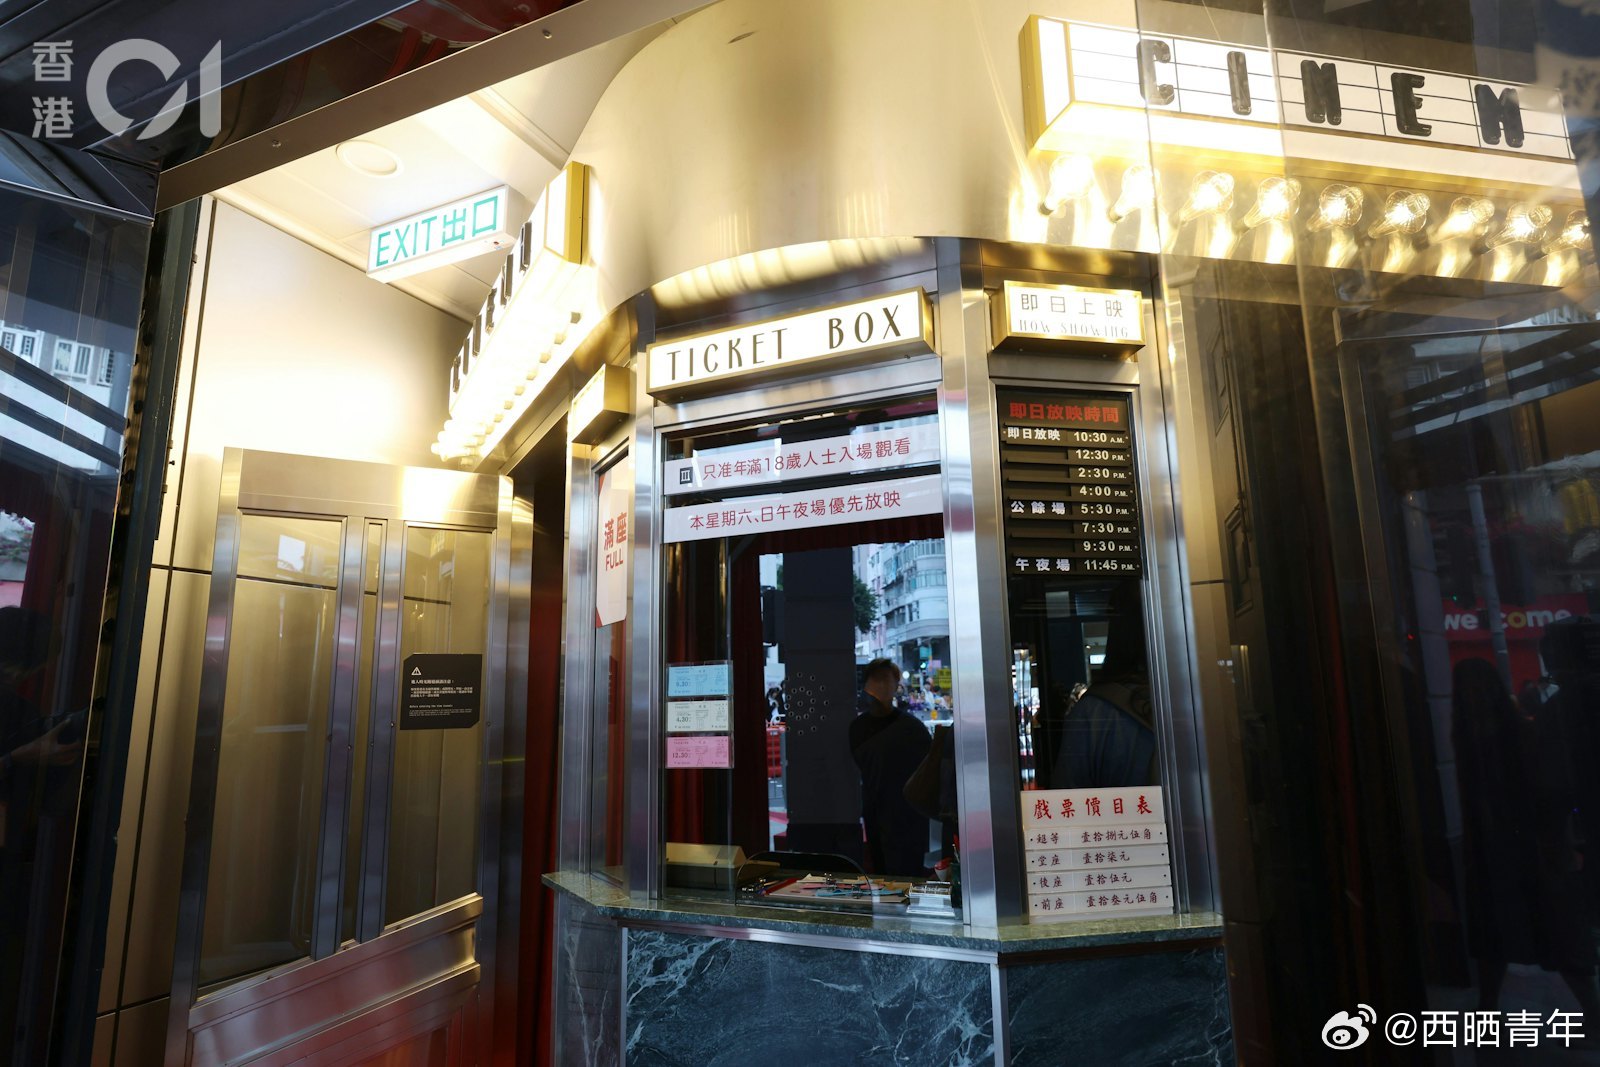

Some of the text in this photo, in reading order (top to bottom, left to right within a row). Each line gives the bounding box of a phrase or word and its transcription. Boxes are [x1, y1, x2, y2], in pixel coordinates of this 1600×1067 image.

[376, 195, 498, 267] EXIT 出口
[1021, 294, 1123, 318] 即日上映
[667, 305, 901, 380] TICKET BOX
[1010, 402, 1119, 423] 即日放映時間
[1007, 427, 1061, 440] 即日放映
[1073, 432, 1107, 443] 10:30
[703, 437, 911, 481] 只准年滿18歲人士入場觀看
[1075, 449, 1109, 461] 12:30
[1078, 467, 1110, 478] 2:30
[1079, 485, 1111, 496] 4:00
[689, 491, 901, 531] 本星期六、日午夜場優先放映
[1010, 501, 1066, 515] 公餘場
[1080, 504, 1113, 515] 5:30
[604, 512, 627, 550] 滿座
[1082, 522, 1114, 533] 7:30
[1083, 541, 1115, 552] 9:30
[606, 548, 623, 571] FULL
[1015, 558, 1071, 571] 午夜場
[1084, 560, 1118, 571] 11:45
[1037, 854, 1061, 867] 堂座
[1039, 872, 1132, 888] 後座 壹拾伍元
[1041, 898, 1065, 911] 前座
